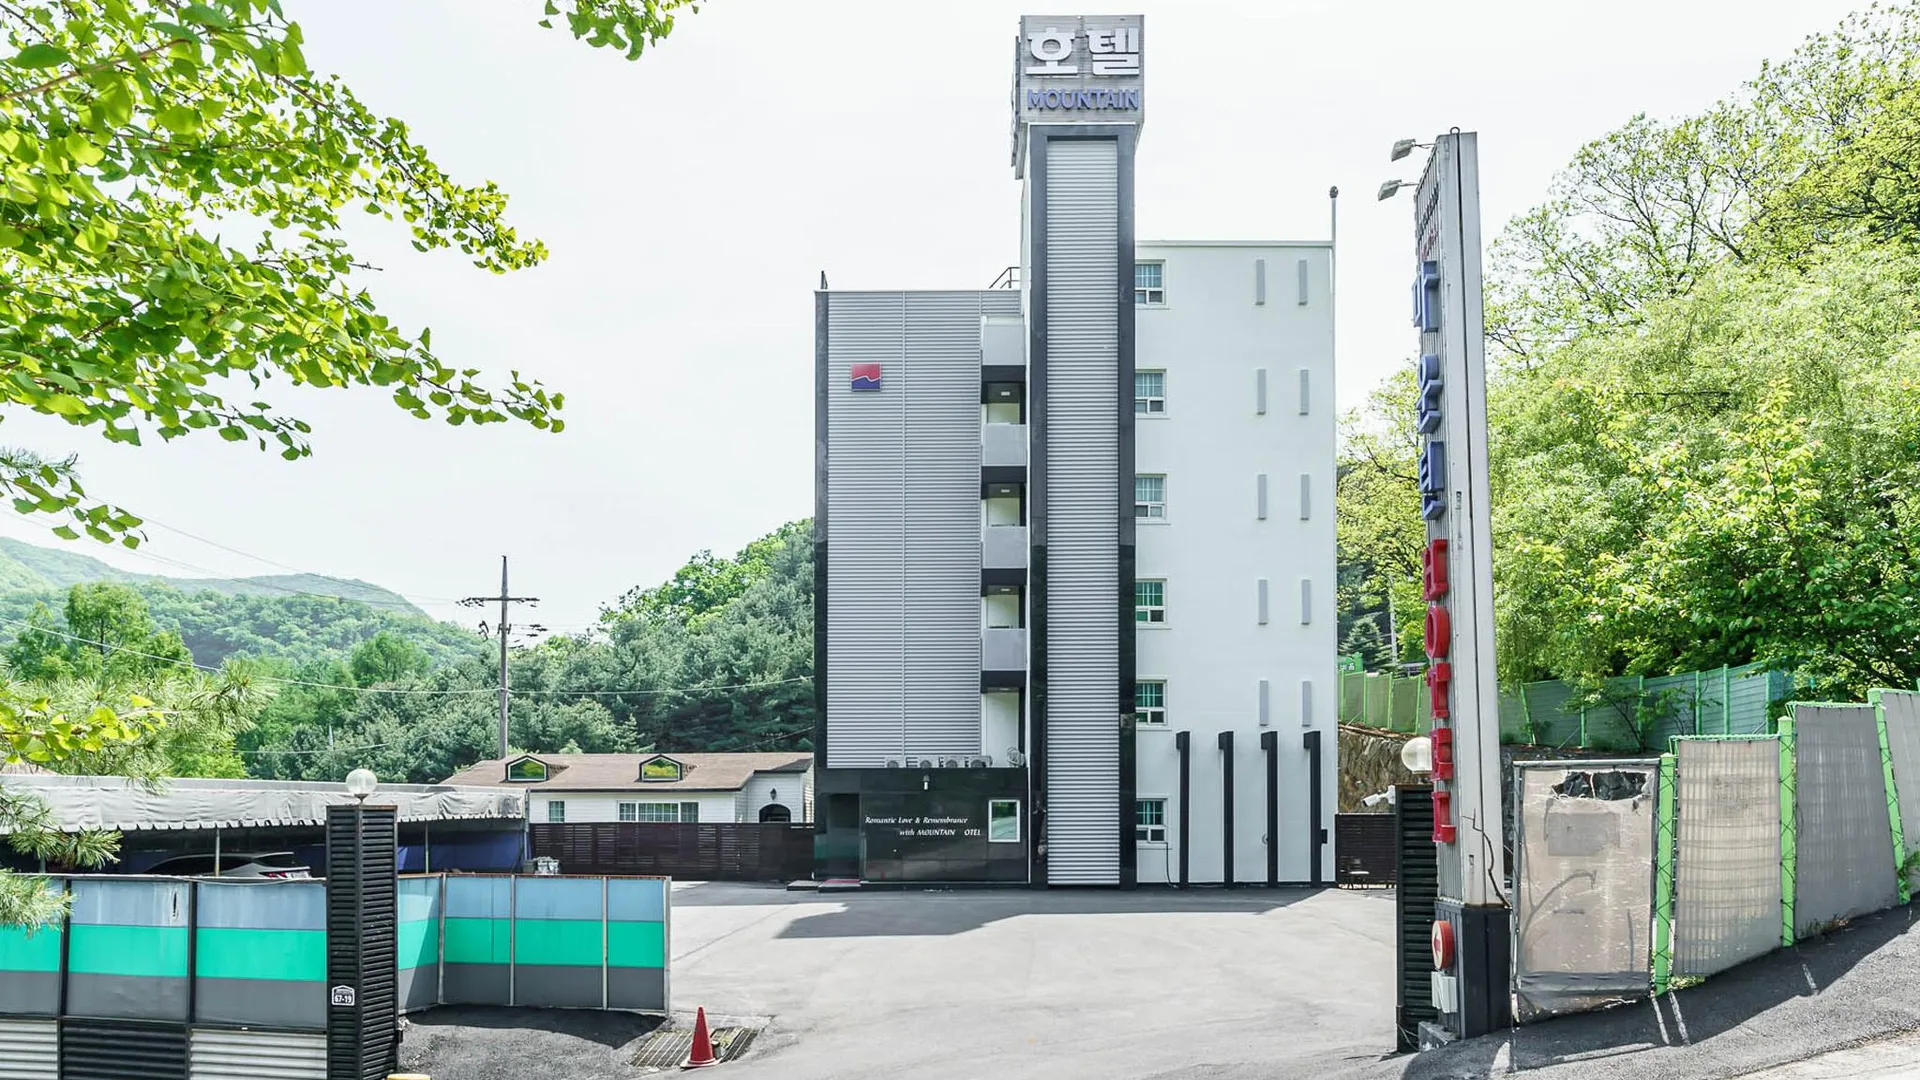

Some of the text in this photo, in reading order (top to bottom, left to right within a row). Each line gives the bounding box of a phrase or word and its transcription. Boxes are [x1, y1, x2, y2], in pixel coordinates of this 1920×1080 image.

[1025, 27, 1140, 76] 호텔
[1027, 88, 1140, 111] MOUNTAIN
[1412, 260, 1446, 520] 마운틴
[1423, 538, 1456, 843] HOTEL
[865, 816, 968, 824] Romantic Love & Remembrance
